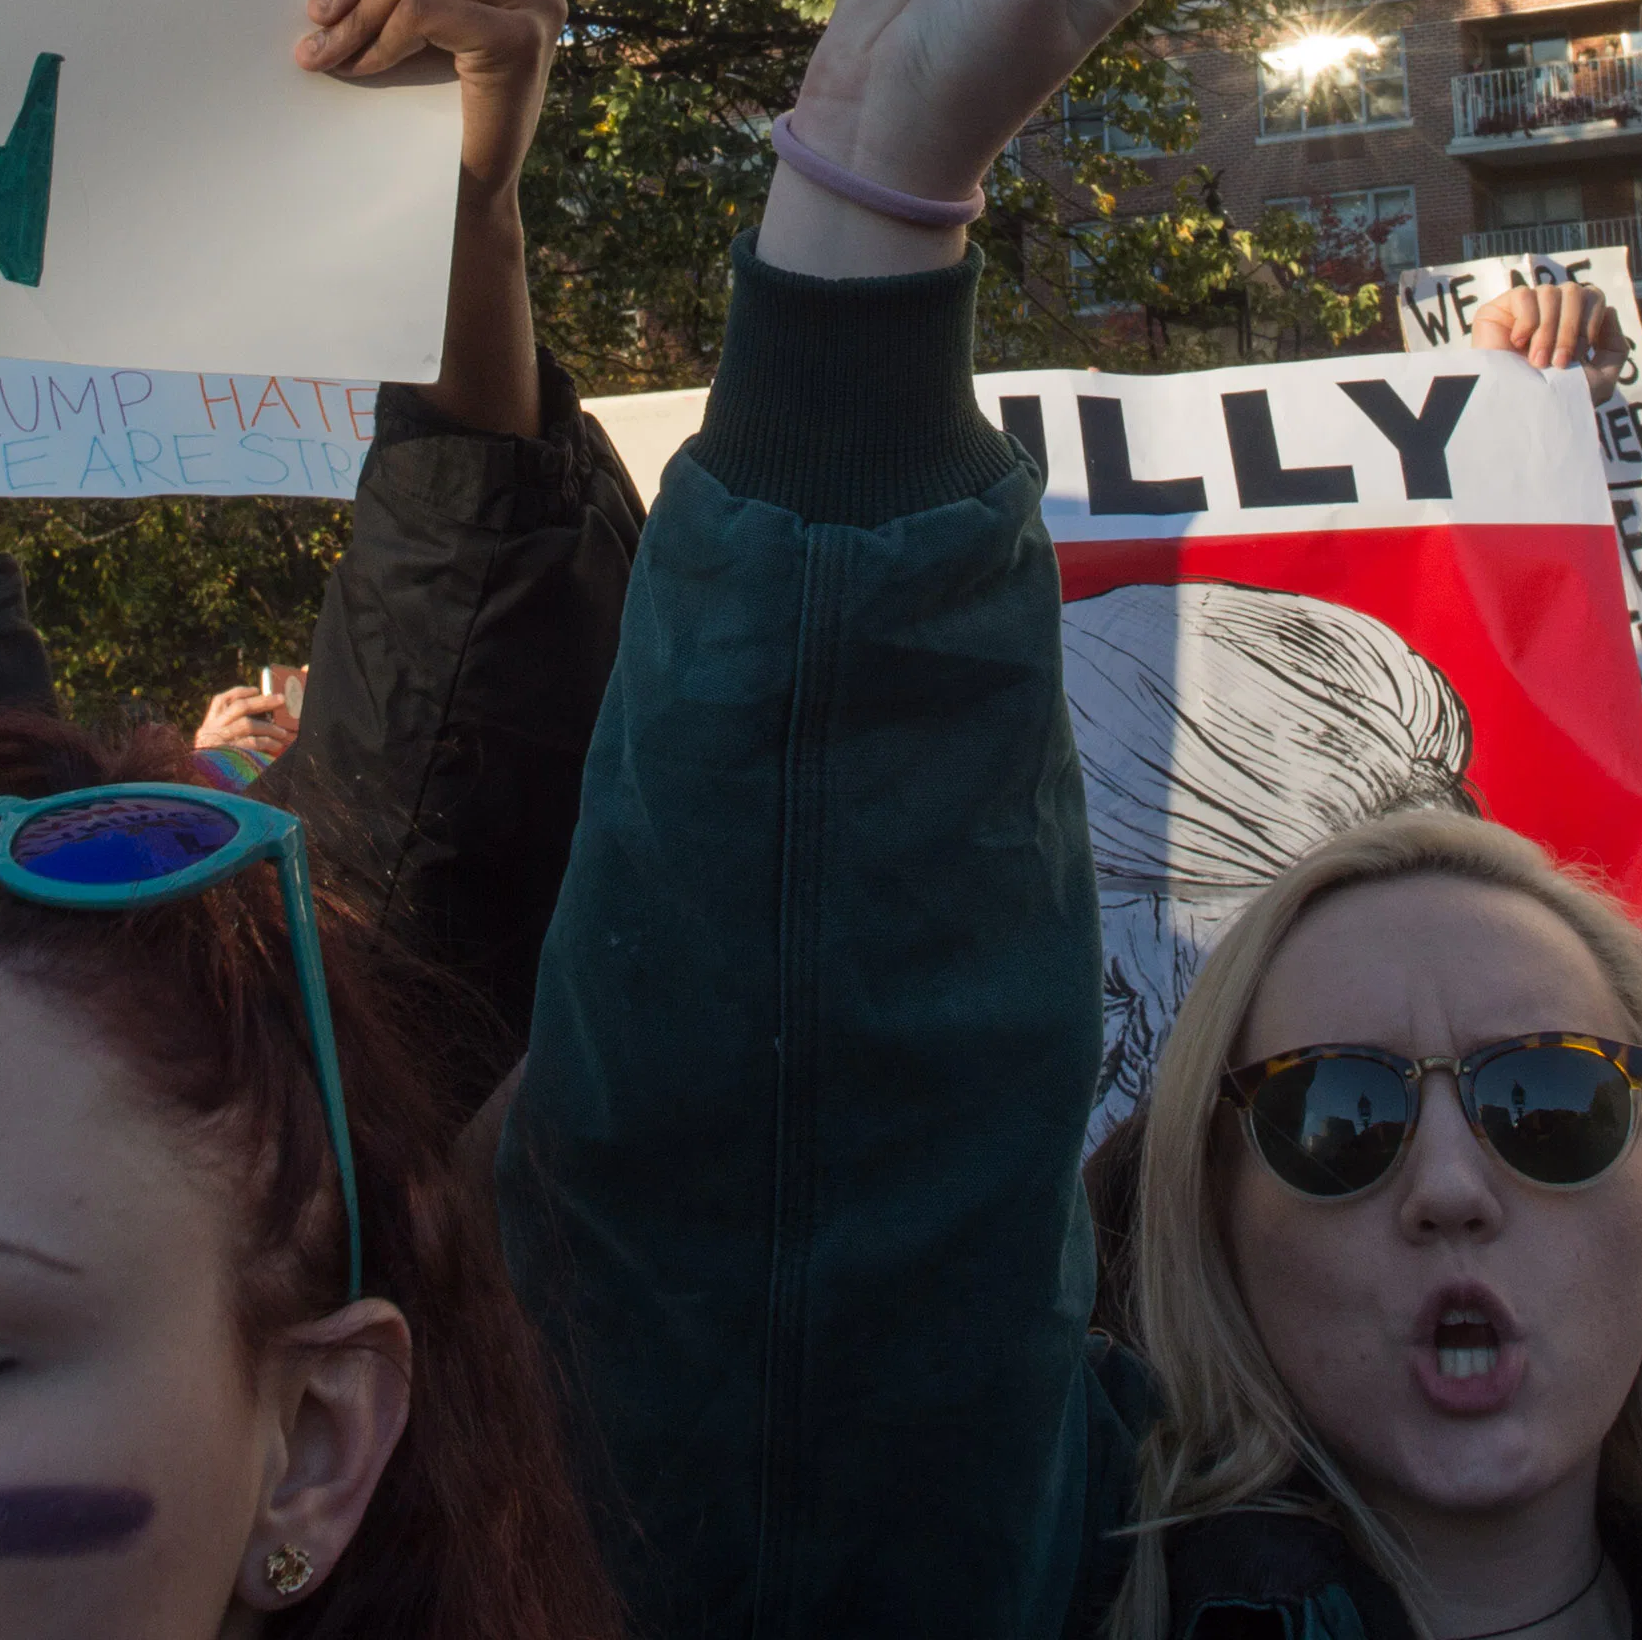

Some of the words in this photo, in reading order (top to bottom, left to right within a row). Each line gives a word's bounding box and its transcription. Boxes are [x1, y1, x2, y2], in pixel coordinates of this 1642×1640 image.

[1404, 273, 1479, 348] WE
[80, 429, 232, 490] ARE
[238, 432, 367, 492] STR
